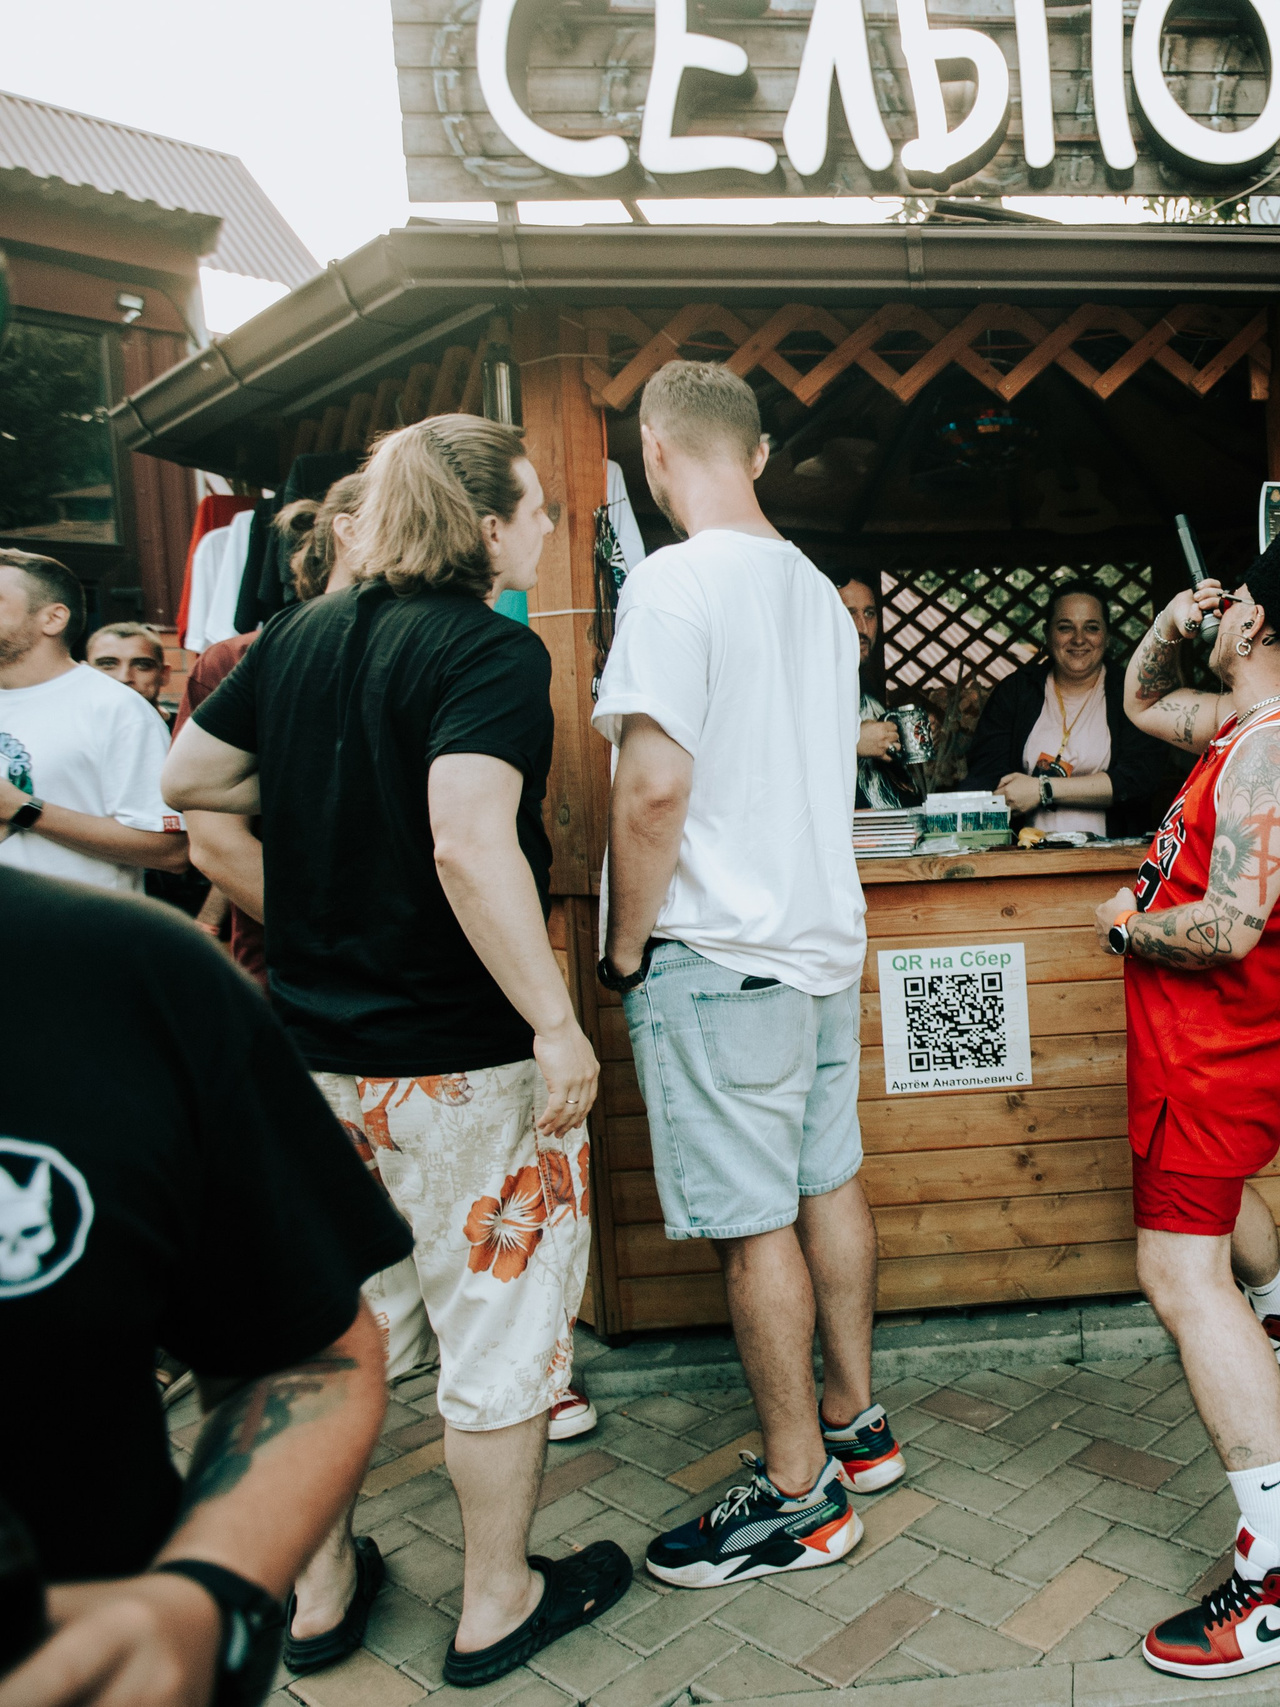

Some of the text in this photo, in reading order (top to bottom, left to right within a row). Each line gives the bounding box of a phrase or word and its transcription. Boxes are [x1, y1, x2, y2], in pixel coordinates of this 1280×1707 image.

[892, 951, 1012, 971] QR на Сбер
[891, 1072, 1028, 1091] Артём Анатольевич С.
